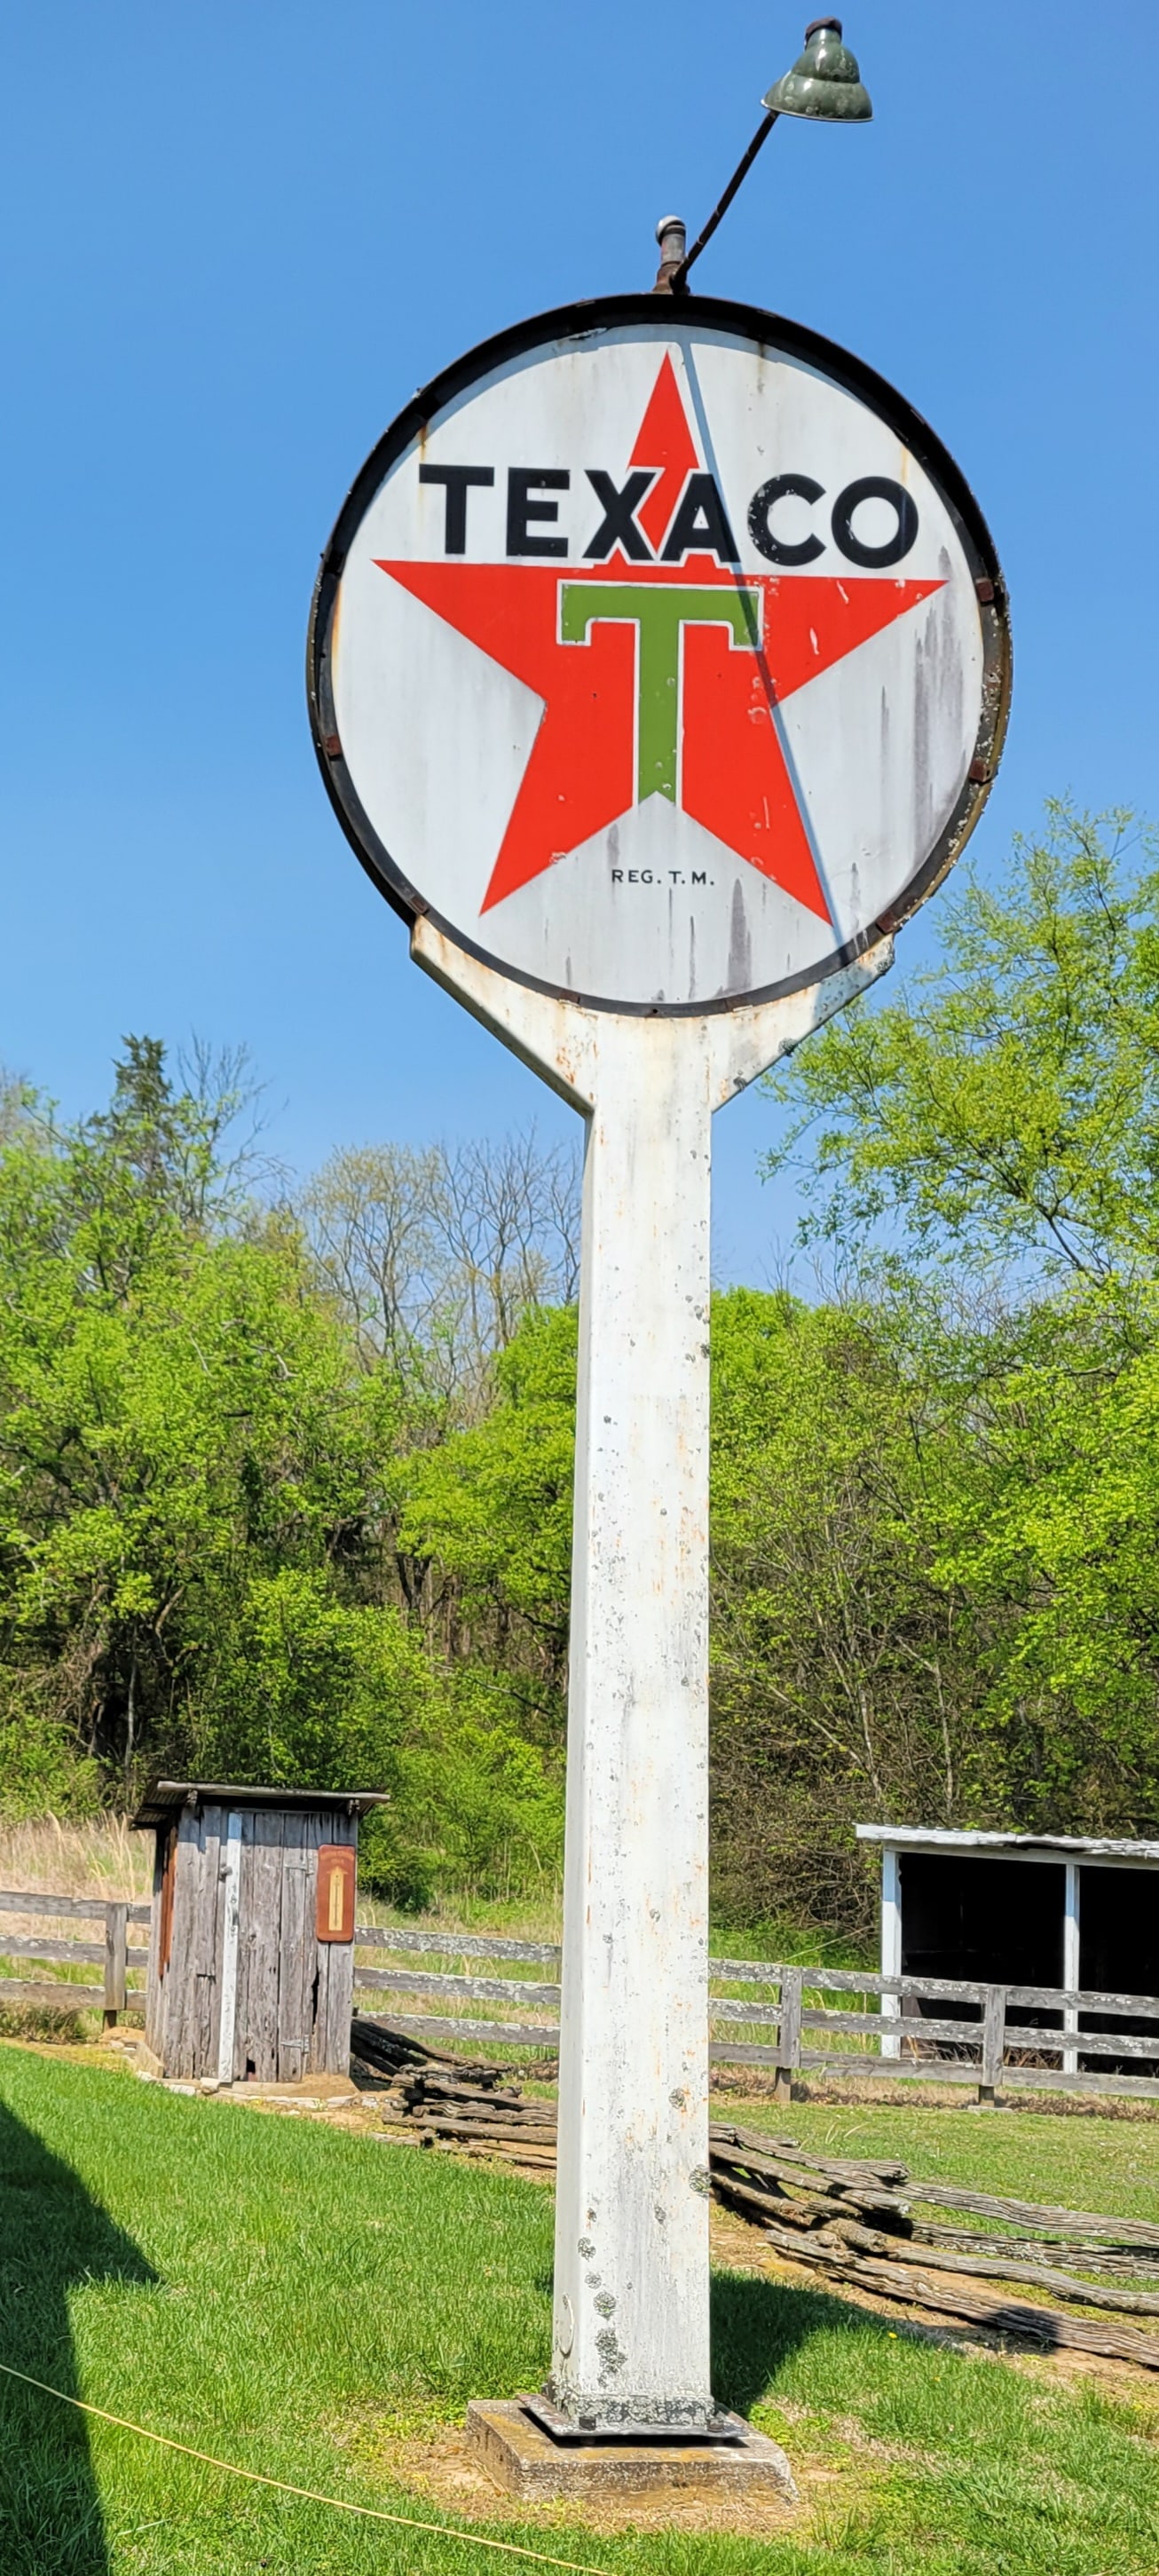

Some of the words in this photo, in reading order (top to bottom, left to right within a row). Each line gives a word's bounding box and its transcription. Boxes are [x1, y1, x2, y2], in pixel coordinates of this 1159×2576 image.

[419, 463, 919, 569] TEXACO
[561, 586, 760, 804] T
[611, 869, 662, 884] REG.
